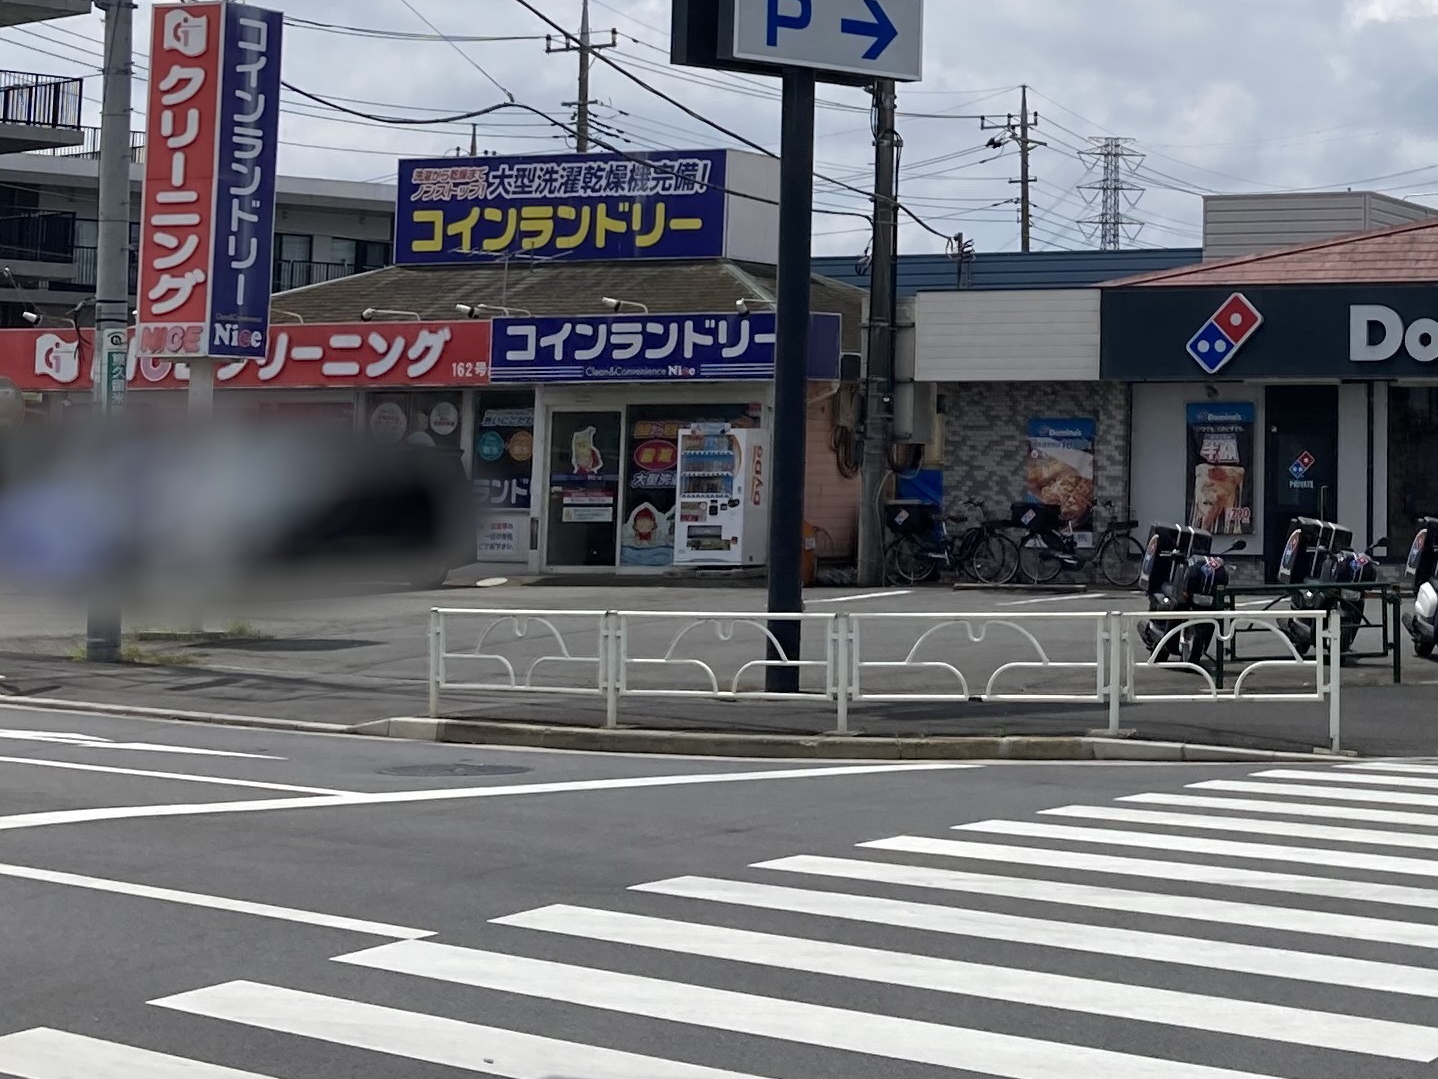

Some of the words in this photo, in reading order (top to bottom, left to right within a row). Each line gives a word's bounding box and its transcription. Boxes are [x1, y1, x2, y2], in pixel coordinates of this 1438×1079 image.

[228, 18, 267, 306] コインランドリー
[487, 160, 711, 200] 大型洗濯乾燥機完備!
[149, 64, 206, 315] クリーニング
[412, 202, 703, 252] コインランドリー
[140, 326, 203, 354] NICE
[213, 323, 262, 349] Nice
[506, 320, 776, 360] コインランドリー
[452, 362, 491, 378] 162号
